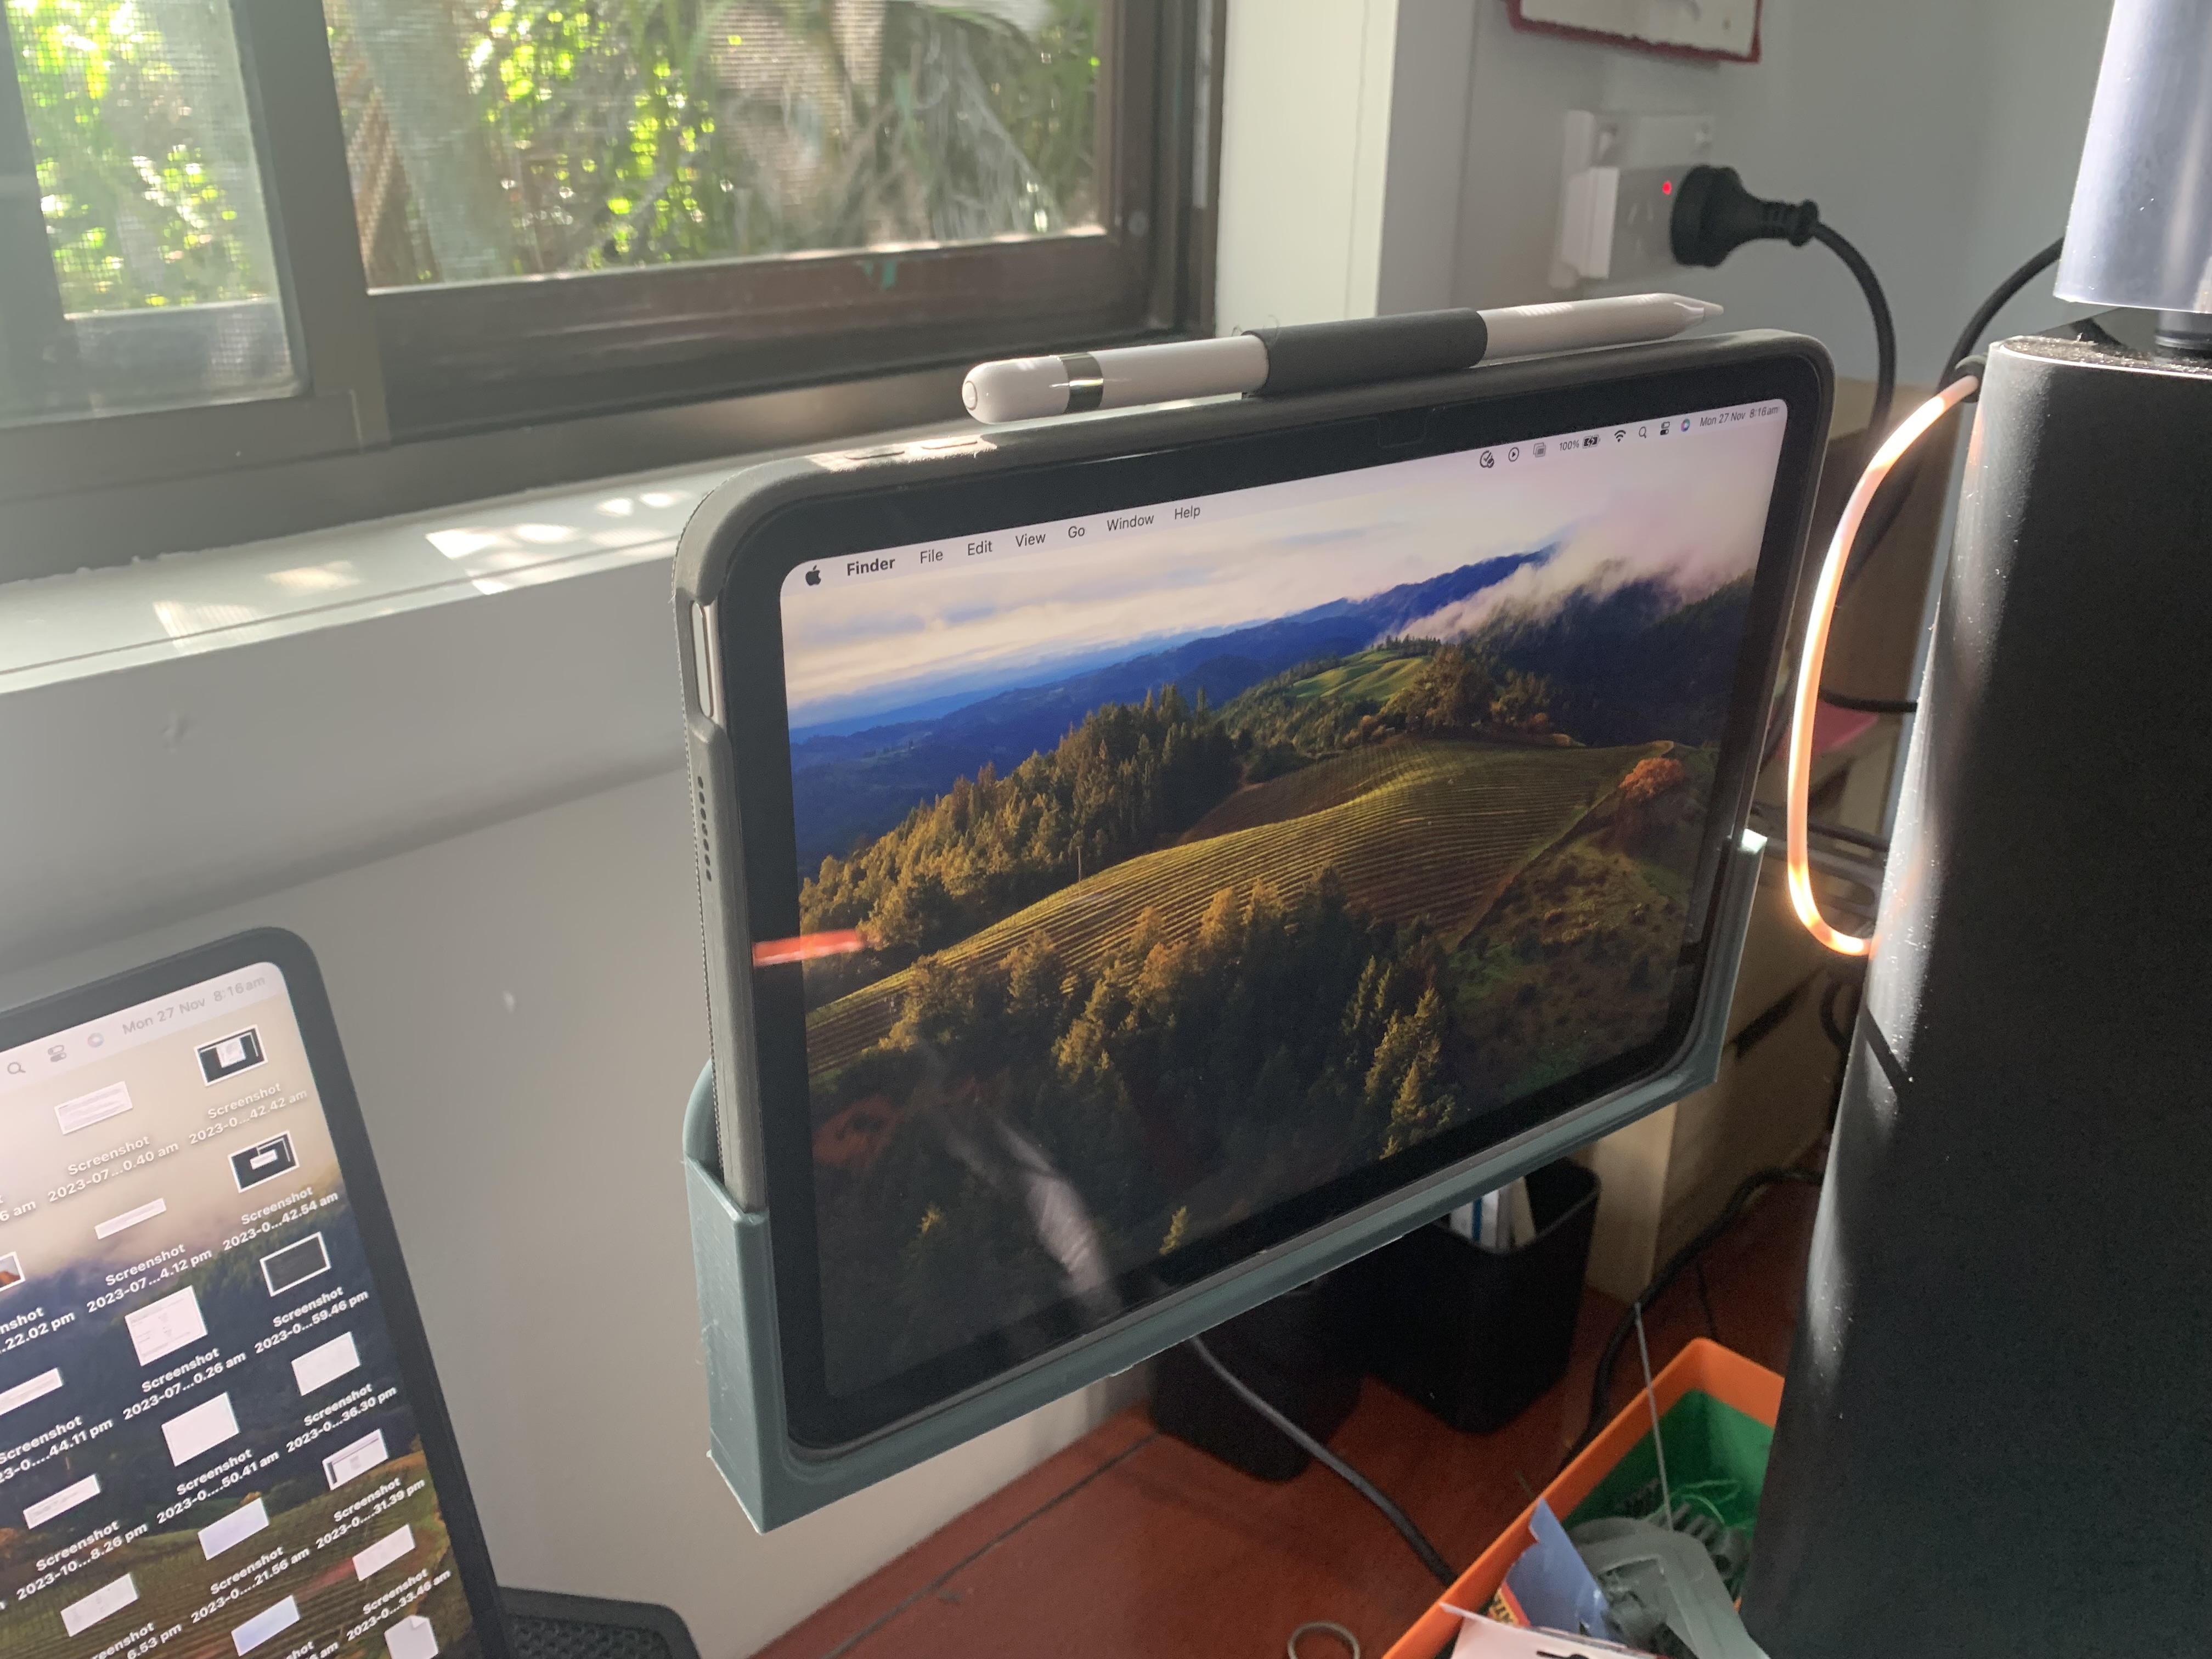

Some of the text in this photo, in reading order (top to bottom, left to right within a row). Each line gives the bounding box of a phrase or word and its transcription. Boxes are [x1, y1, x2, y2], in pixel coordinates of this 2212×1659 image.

[1700, 417, 1716, 426] Mon
[1719, 413, 1729, 424] 27
[1731, 412, 1746, 421] Nov
[1560, 439, 1579, 450] 100%
[847, 505, 1201, 576] Finder File Edit View Go Window Help
[122, 1016, 154, 1035] Mon
[157, 1007, 174, 1023] 27
[179, 998, 205, 1014] Nov
[207, 1083, 281, 1120] Screenshot
[289, 1090, 308, 1104] am
[67, 1136, 150, 1176] Screenshot
[158, 1142, 179, 1158] am
[13, 1201, 36, 1216] am
[241, 1186, 313, 1226] Screenshot
[319, 1192, 338, 1207] am
[105, 1244, 186, 1286] Screenshot
[191, 1249, 213, 1268] pm
[273, 1286, 344, 1328] Screenshot
[348, 1291, 369, 1308] pm
[50, 1312, 75, 1332] pm
[142, 1347, 220, 1393] Screenshot
[225, 1351, 247, 1369] am
[303, 1383, 373, 1427] Screenshot
[377, 1386, 398, 1404] pm
[89, 1419, 114, 1439] pm
[259, 1451, 280, 1468] am
[177, 1448, 253, 1496] Screenshot
[407, 1479, 426, 1497] pm
[334, 1477, 402, 1522] Screenshot
[125, 1523, 149, 1544] pm
[36, 1520, 120, 1572] Screenshot
[291, 1548, 311, 1564] am
[210, 1546, 285, 1595] Screenshot
[433, 1570, 452, 1586] am
[363, 1568, 429, 1615] Screenshot
[160, 1623, 182, 1644] pm
[320, 1642, 339, 1658] am
